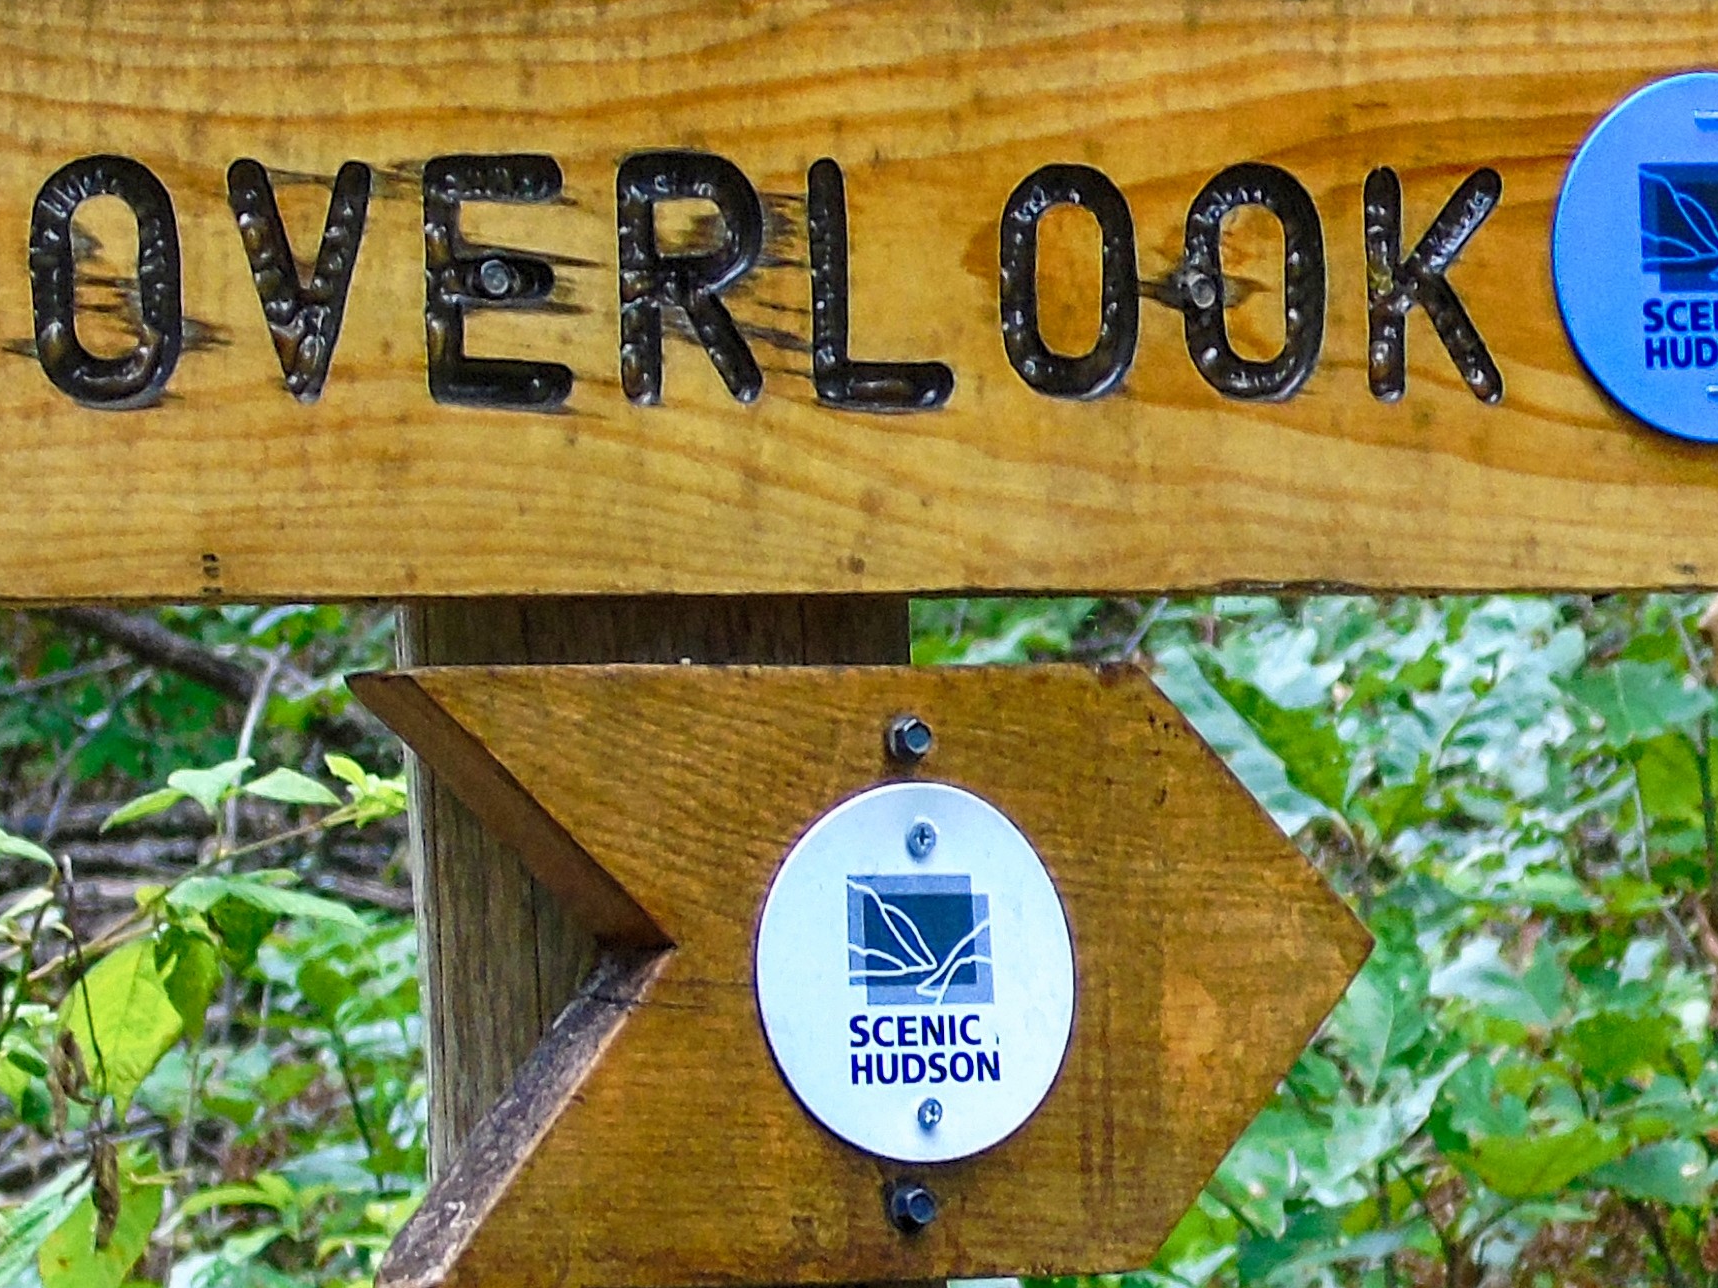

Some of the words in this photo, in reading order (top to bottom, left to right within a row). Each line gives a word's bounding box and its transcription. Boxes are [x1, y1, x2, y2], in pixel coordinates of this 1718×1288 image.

[30, 152, 1504, 410] OVERLOOK
[849, 1015, 981, 1047] SCENIC
[850, 1051, 1000, 1085] HUDSON
